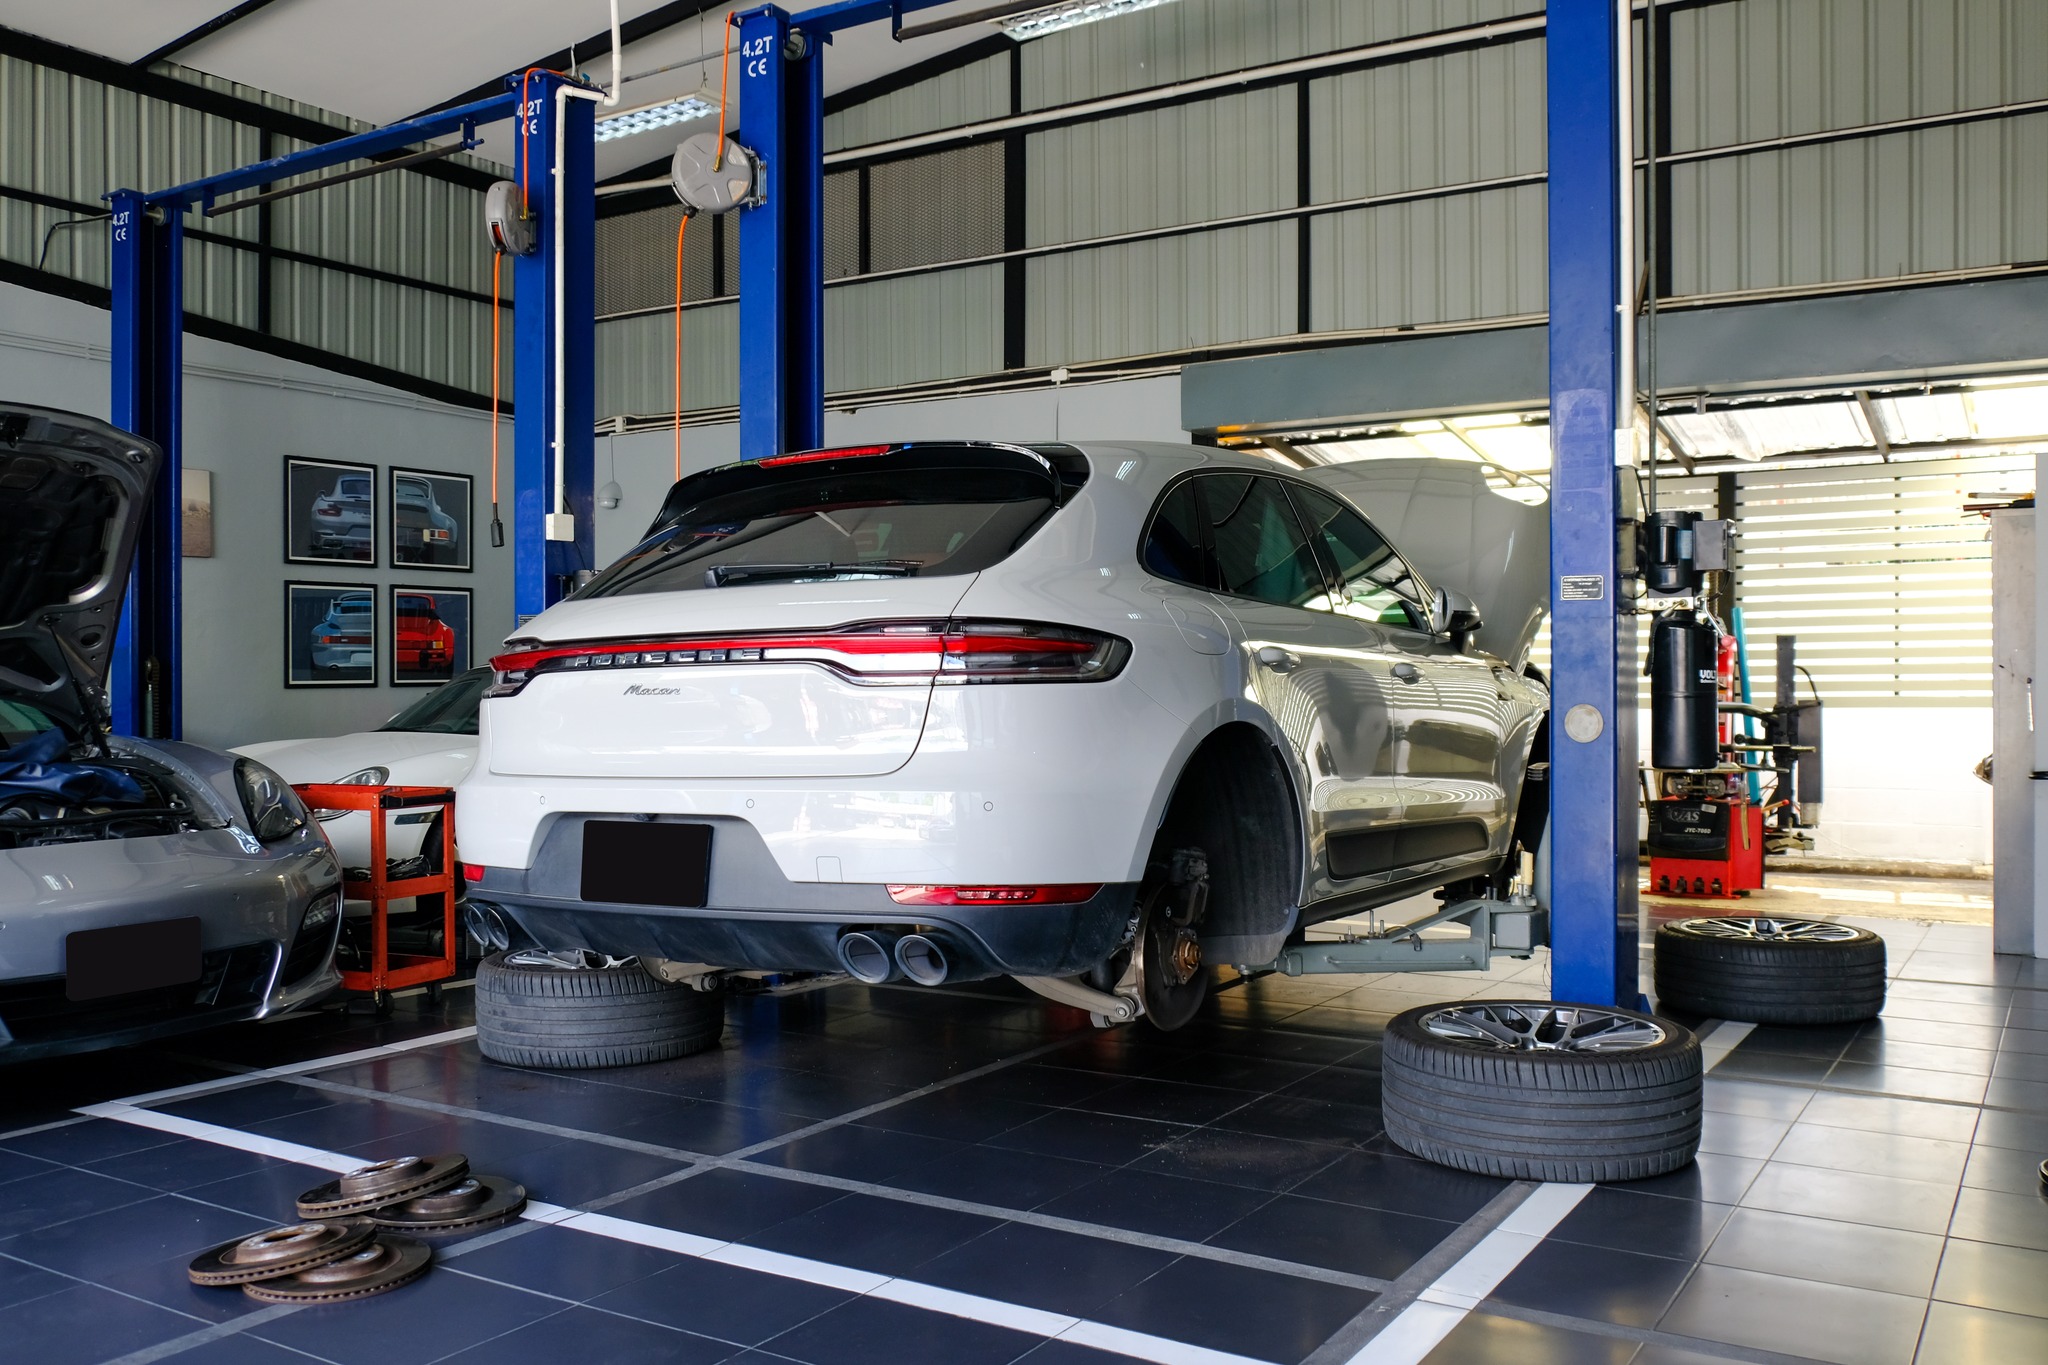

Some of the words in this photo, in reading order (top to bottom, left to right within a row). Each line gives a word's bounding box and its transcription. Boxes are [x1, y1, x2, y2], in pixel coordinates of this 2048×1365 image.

[743, 36, 773, 57] 4.2T
[748, 58, 767, 78] CE
[517, 99, 543, 118] 42T
[112, 211, 130, 226] 4.2T
[574, 649, 761, 667] PORSCHE
[623, 683, 681, 696] Macan
